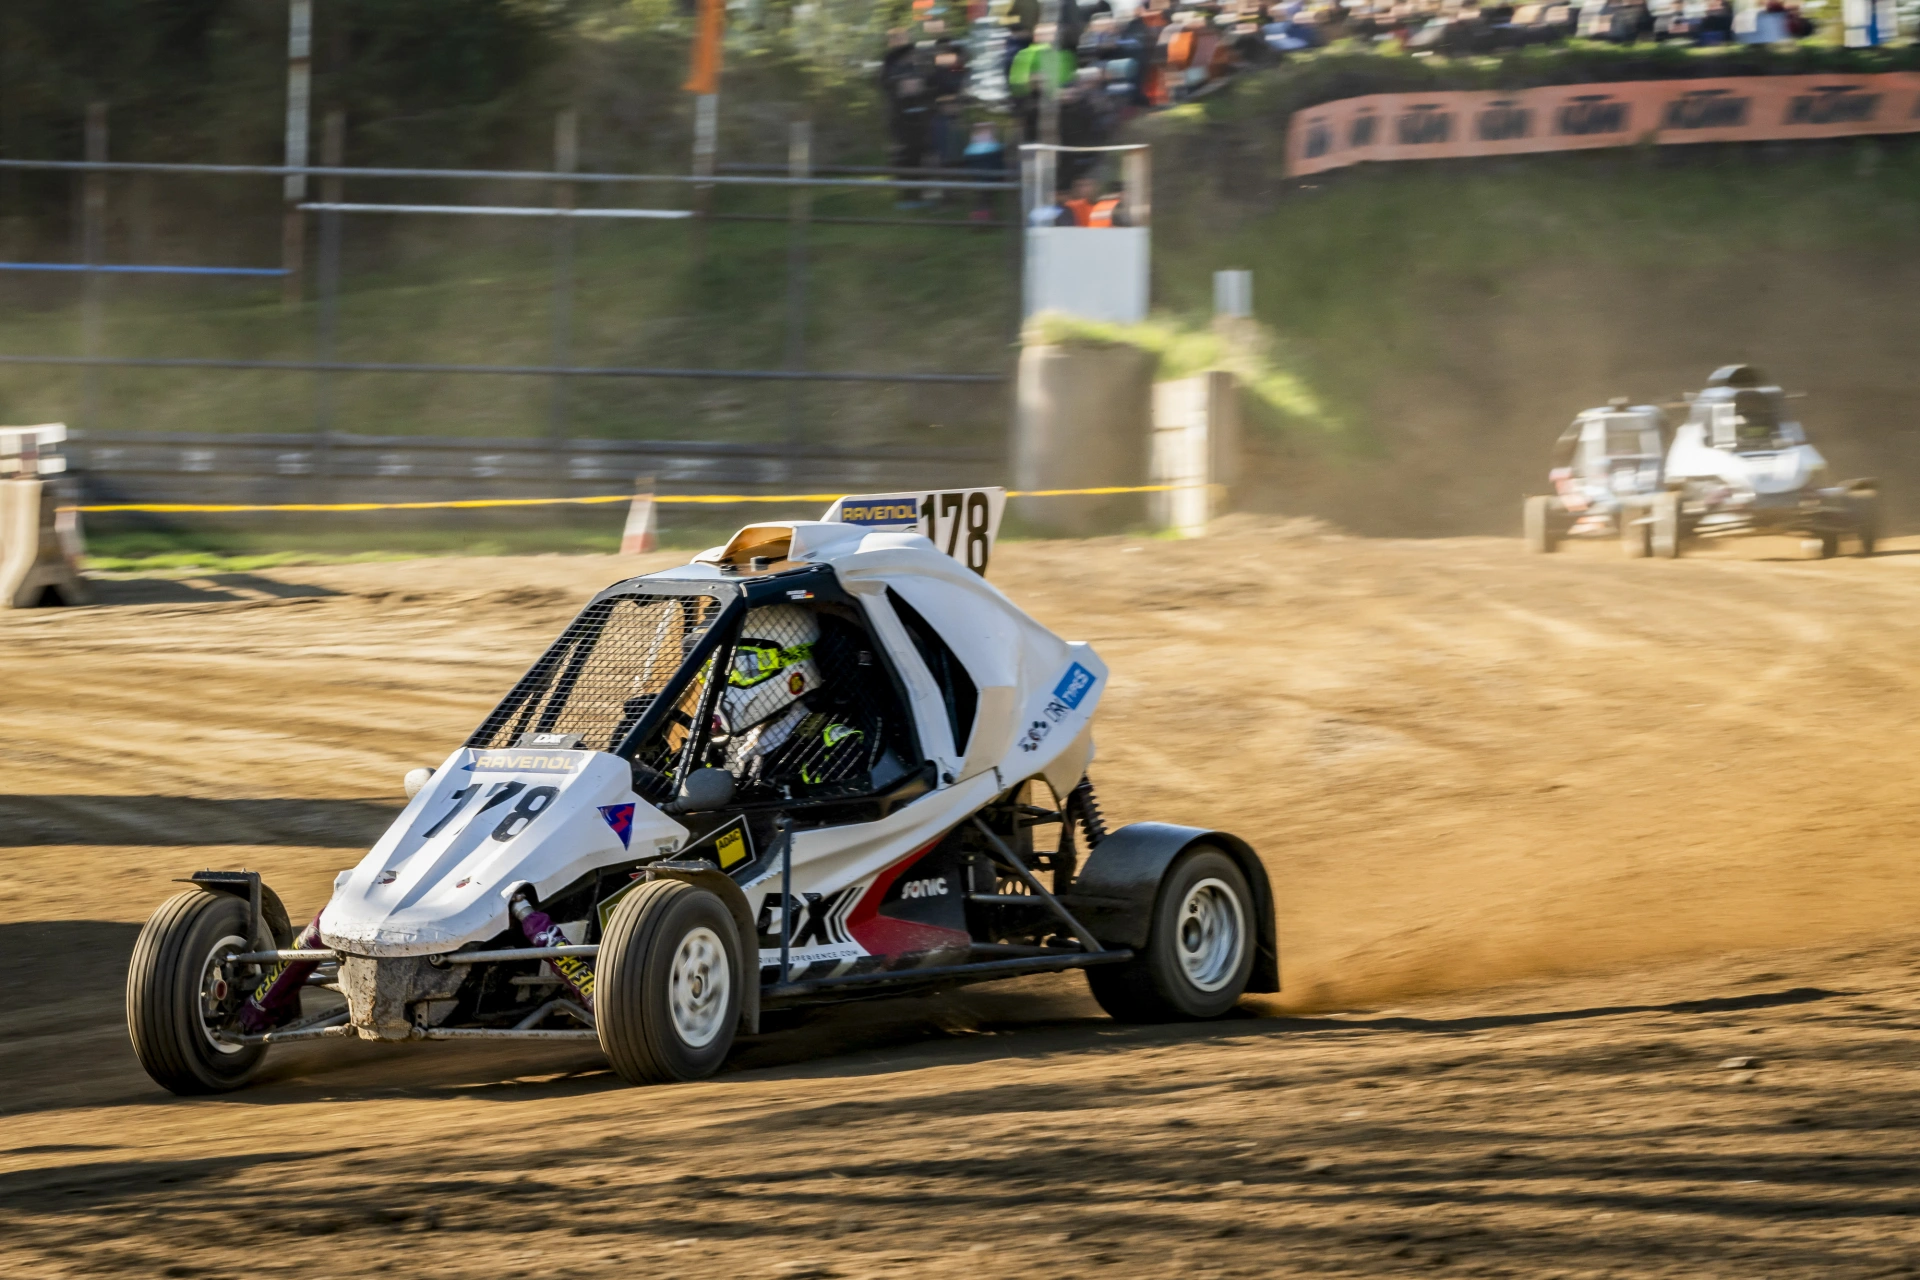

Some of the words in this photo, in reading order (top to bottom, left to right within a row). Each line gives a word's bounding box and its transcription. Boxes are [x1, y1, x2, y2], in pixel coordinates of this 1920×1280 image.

[842, 504, 917, 522] RAVENOL
[921, 491, 989, 577] 178
[475, 755, 575, 770] RAVENOL
[423, 780, 561, 842] 178
[718, 828, 741, 850] ADAC
[757, 889, 846, 949] DX
